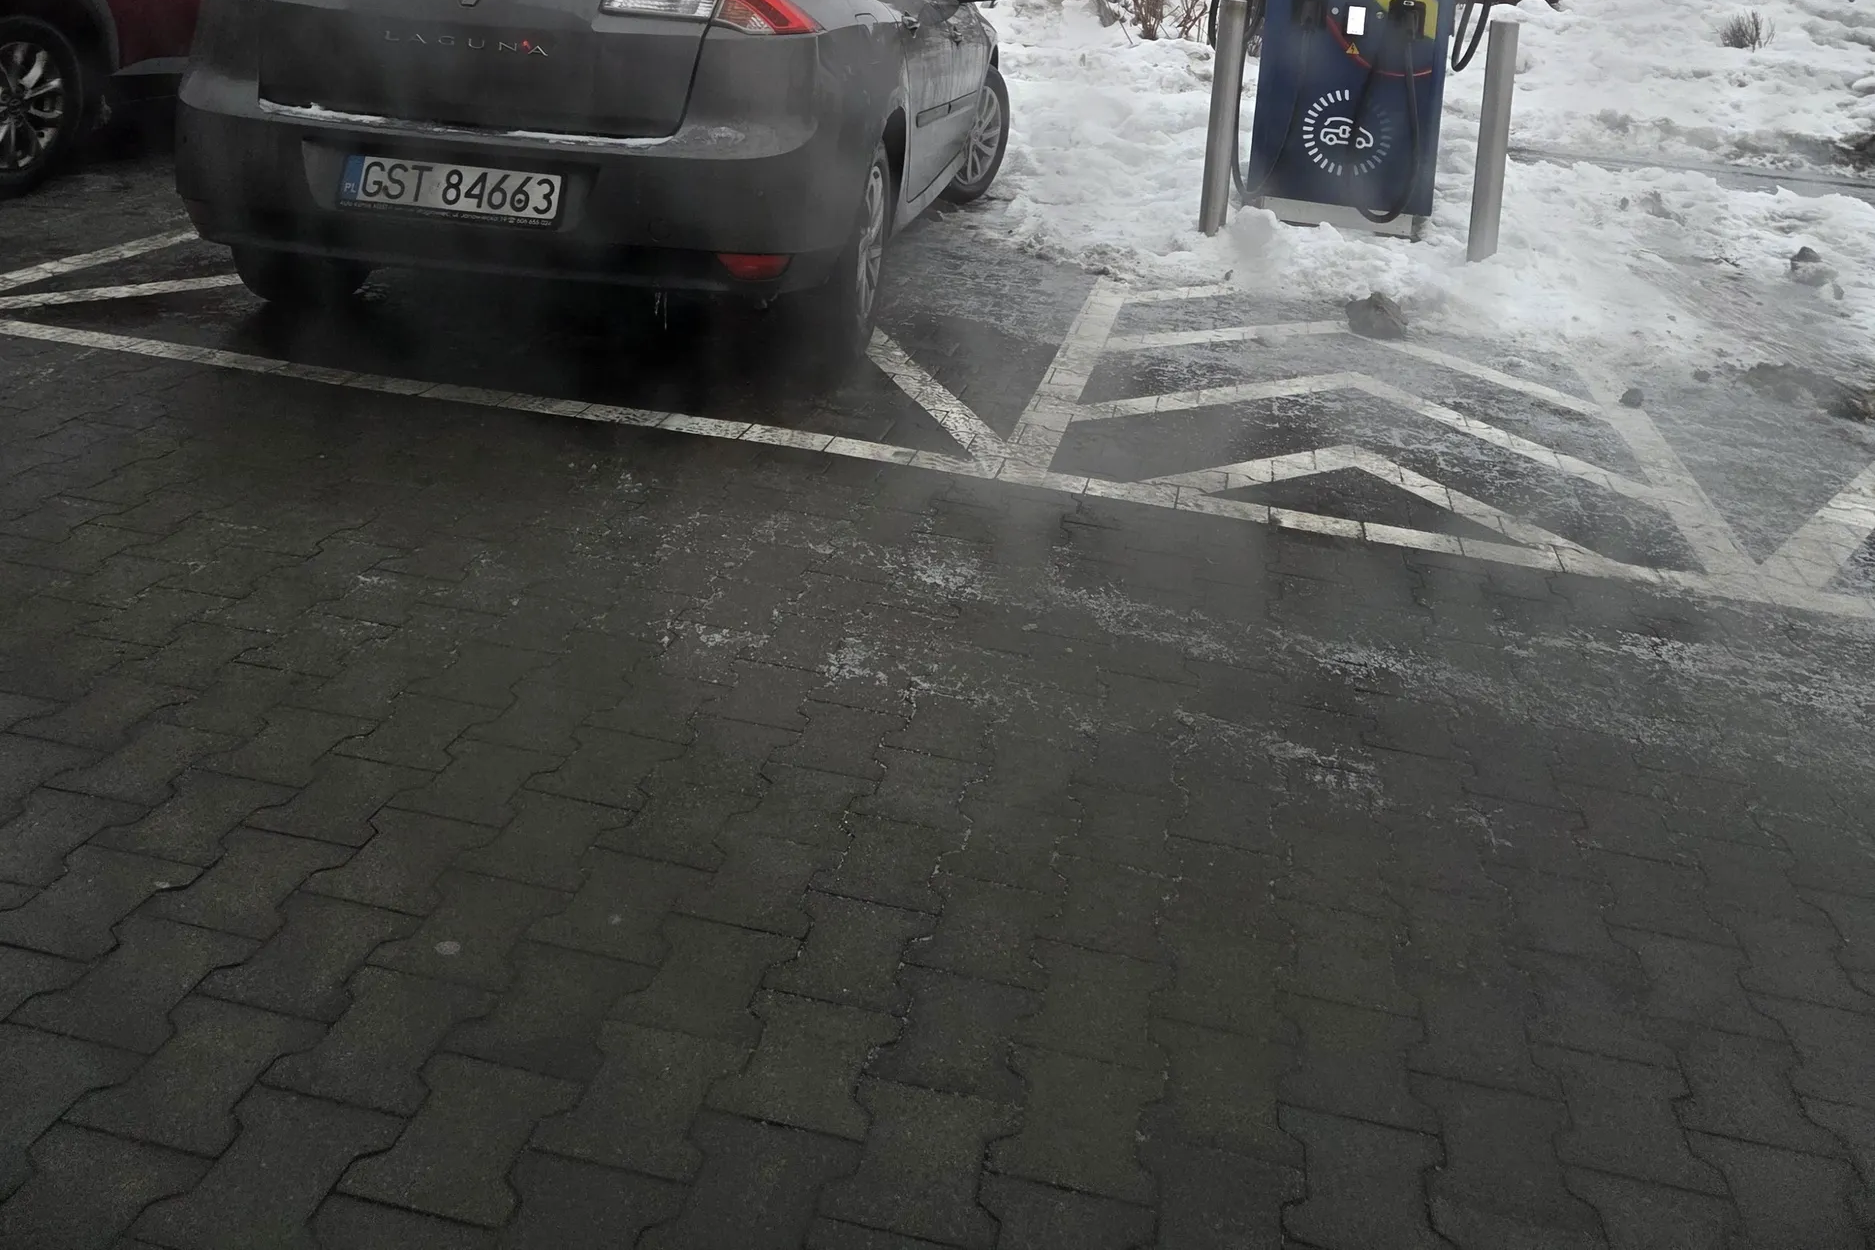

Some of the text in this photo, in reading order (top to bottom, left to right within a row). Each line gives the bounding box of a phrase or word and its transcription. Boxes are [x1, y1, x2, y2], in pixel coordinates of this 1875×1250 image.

[384, 30, 548, 57] LAGUNA
[343, 182, 356, 193] PL
[361, 161, 555, 215] GST 84663
